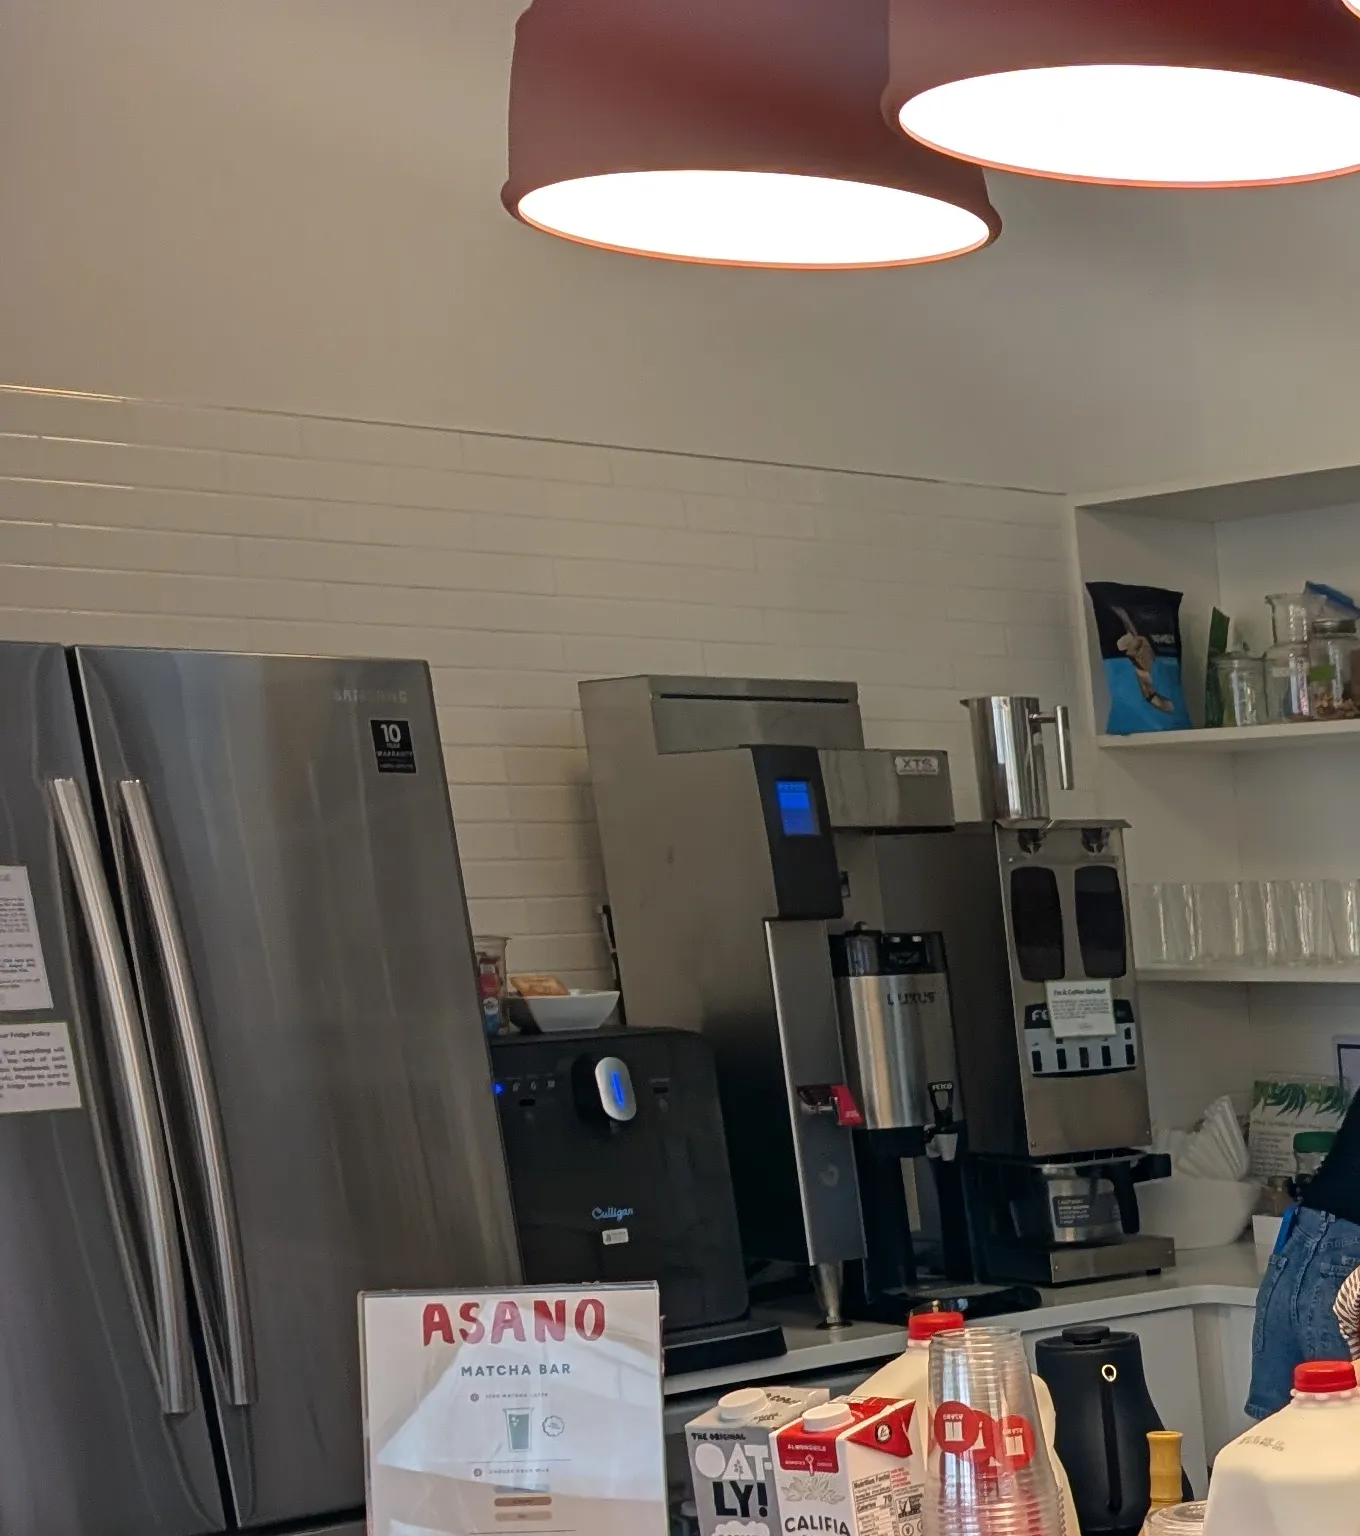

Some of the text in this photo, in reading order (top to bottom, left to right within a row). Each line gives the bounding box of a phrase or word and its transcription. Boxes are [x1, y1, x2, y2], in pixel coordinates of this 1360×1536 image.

[380, 723, 402, 743] 10
[592, 1206, 634, 1222] Culligan
[422, 1298, 606, 1347] ASANO
[461, 1363, 571, 1377] MATCHA BAR
[712, 1481, 768, 1518] LY!
